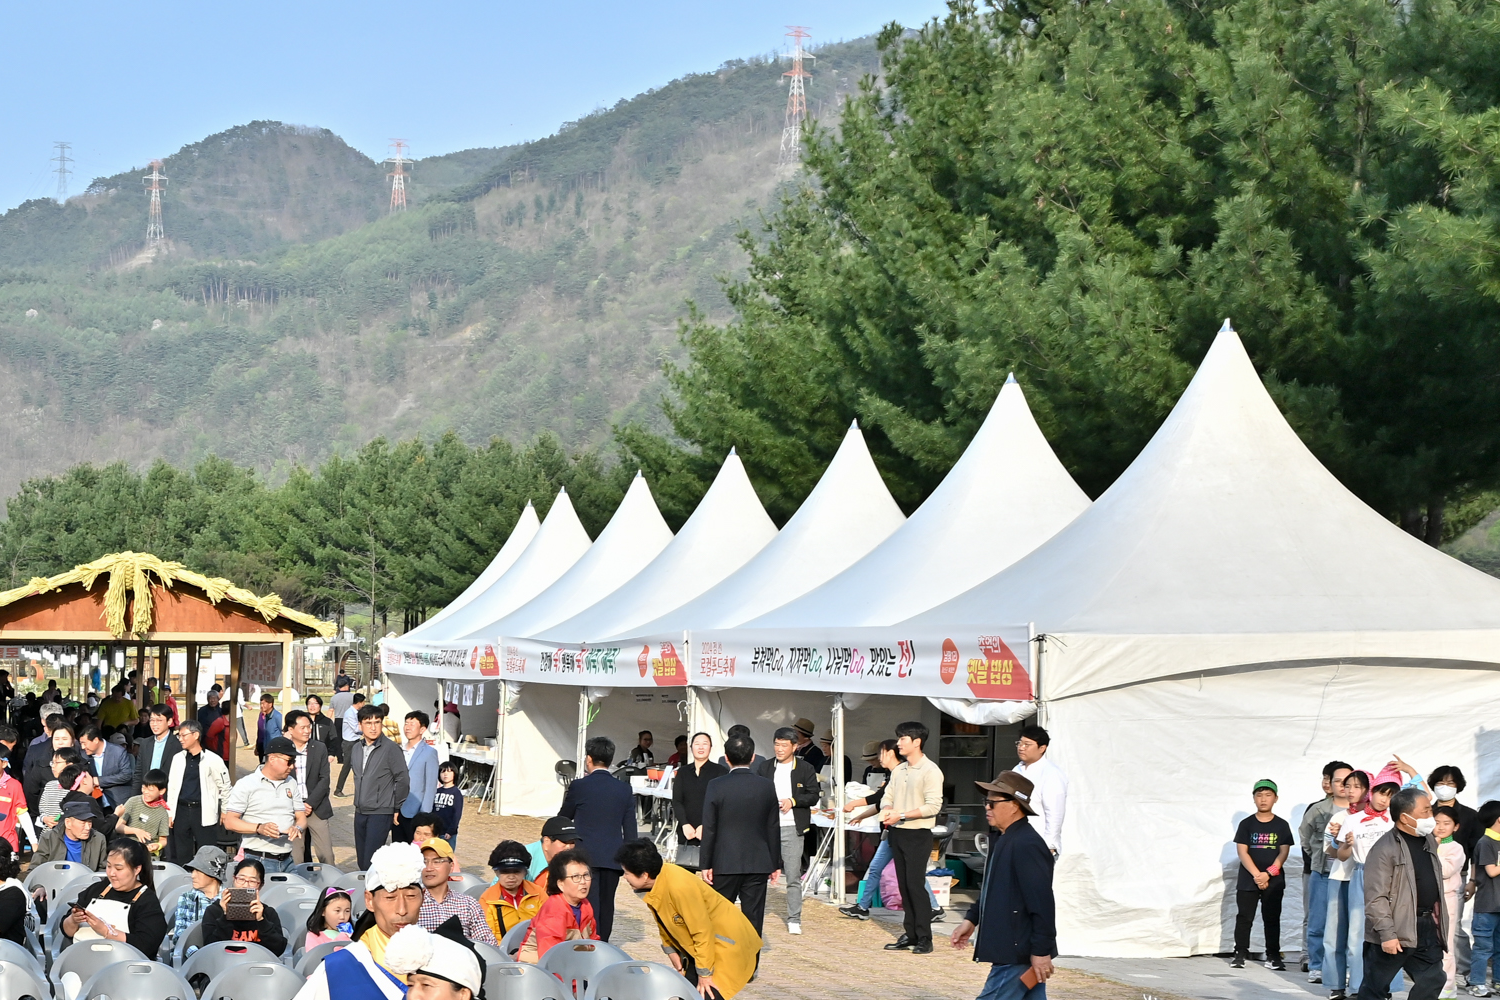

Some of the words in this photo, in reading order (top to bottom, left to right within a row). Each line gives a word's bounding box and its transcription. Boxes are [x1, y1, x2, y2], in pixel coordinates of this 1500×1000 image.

[979, 636, 1001, 653] 추억의
[700, 656, 736, 677] 로컬푸드축제
[866, 647, 896, 677] 맛있는
[897, 639, 915, 678] 전!
[967, 659, 989, 685] 옛날
[990, 659, 1013, 685] 밥상
